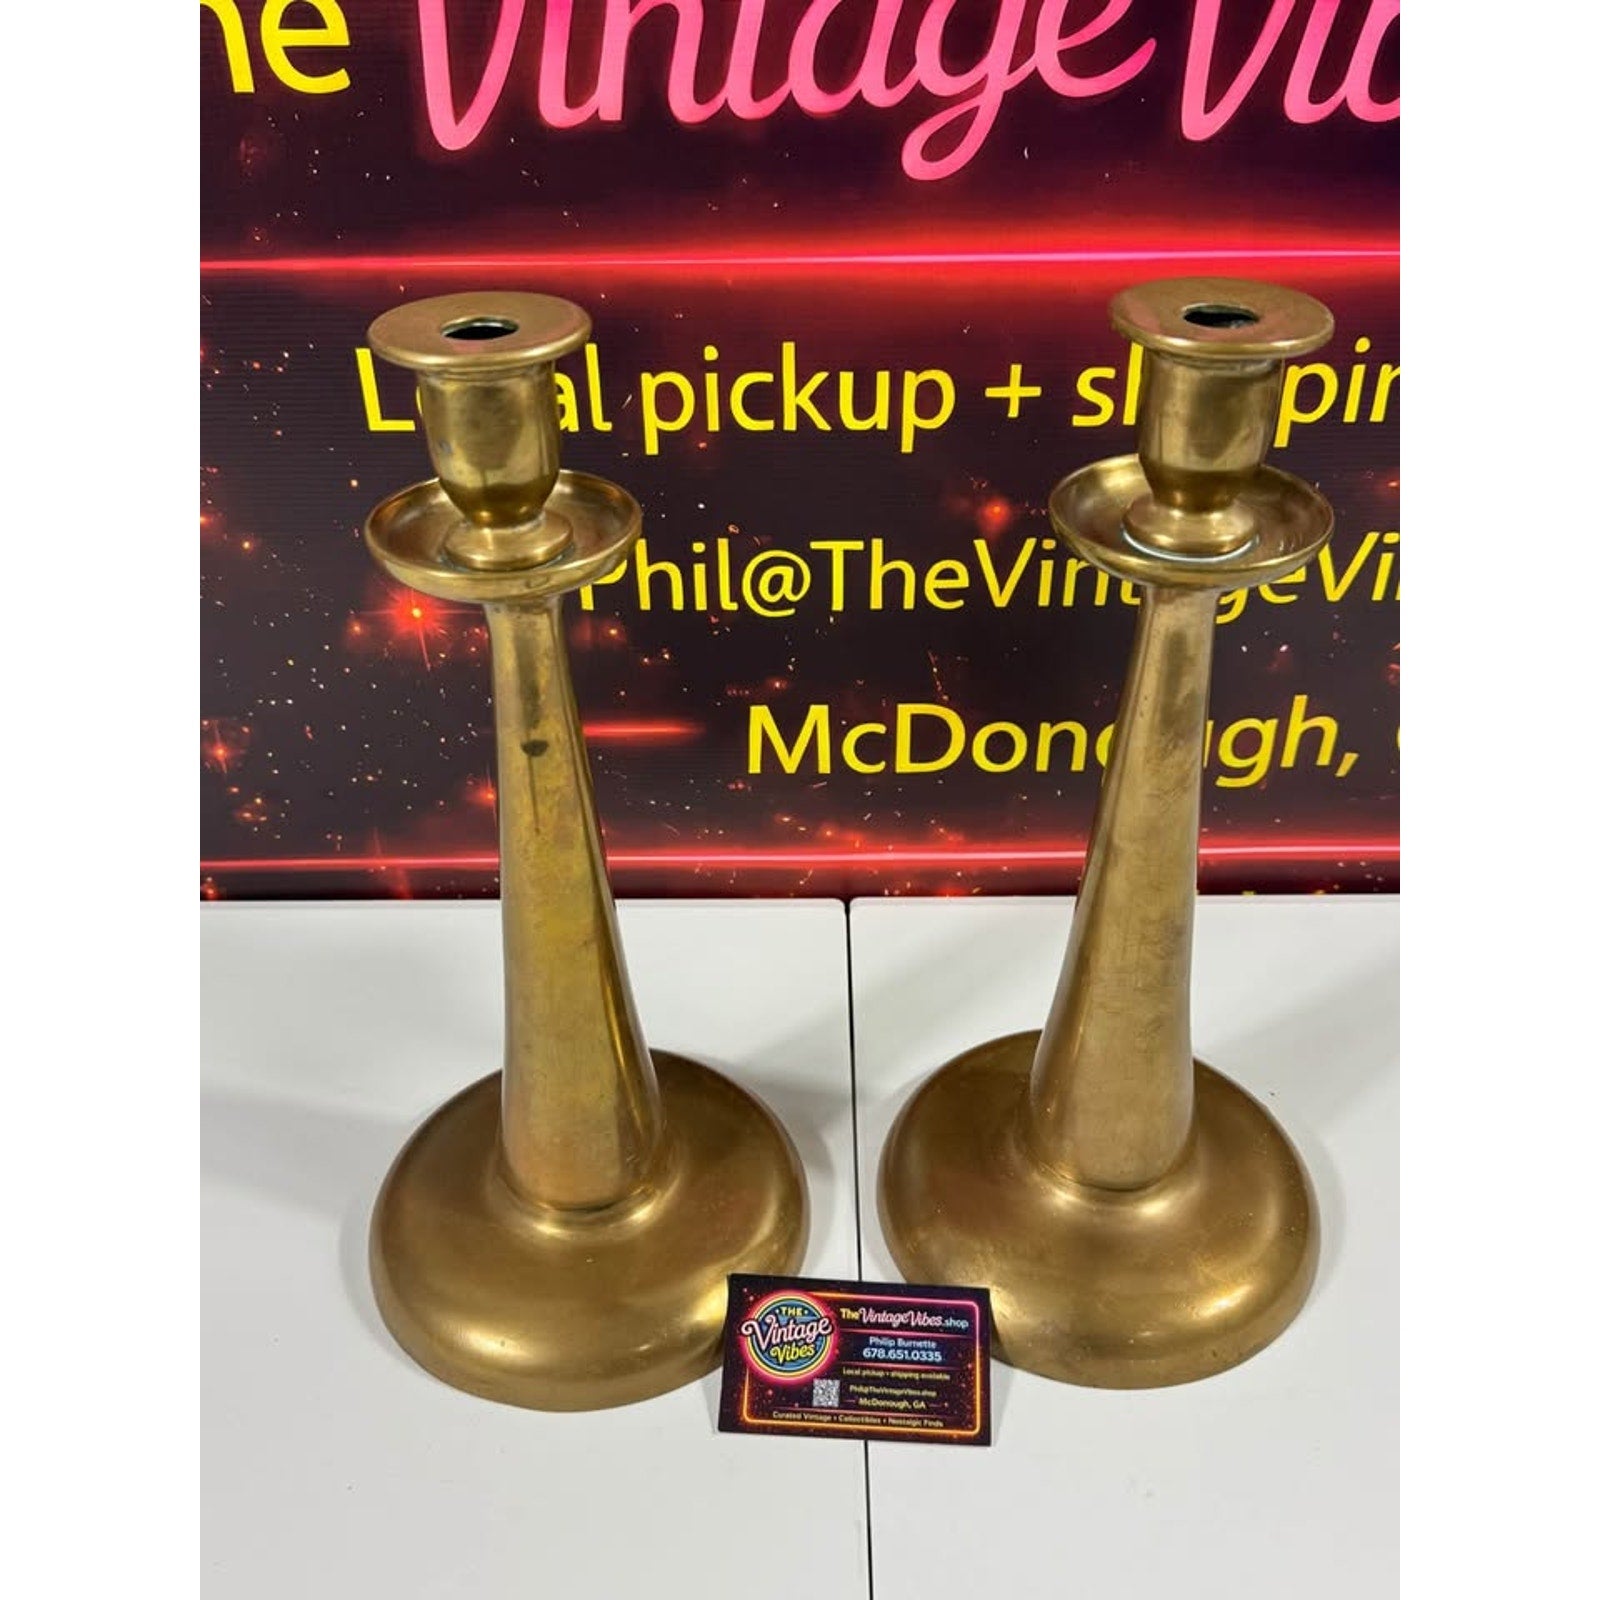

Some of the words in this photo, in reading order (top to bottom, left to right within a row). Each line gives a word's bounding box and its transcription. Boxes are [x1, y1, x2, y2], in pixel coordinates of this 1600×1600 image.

[355, 343, 613, 432] Lal
[641, 341, 956, 455] pickup
[985, 364, 1042, 418] +
[748, 694, 1360, 788] McDongh,
[780, 1306, 803, 1317] THE
[741, 1314, 833, 1351] Vintage
[869, 1336, 896, 1347] Philip
[897, 1338, 937, 1349] Burnette
[770, 1341, 815, 1364] Vibes
[862, 1347, 943, 1362] 678.651.0335
[858, 1397, 912, 1410] McDonough,
[912, 1401, 927, 1410] GA
[772, 1410, 801, 1420] Curated
[803, 1412, 832, 1422] Vintage
[838, 1414, 881, 1425] Collectibles
[888, 1417, 922, 1428] Nostalgic
[922, 1419, 945, 1428] Finds
